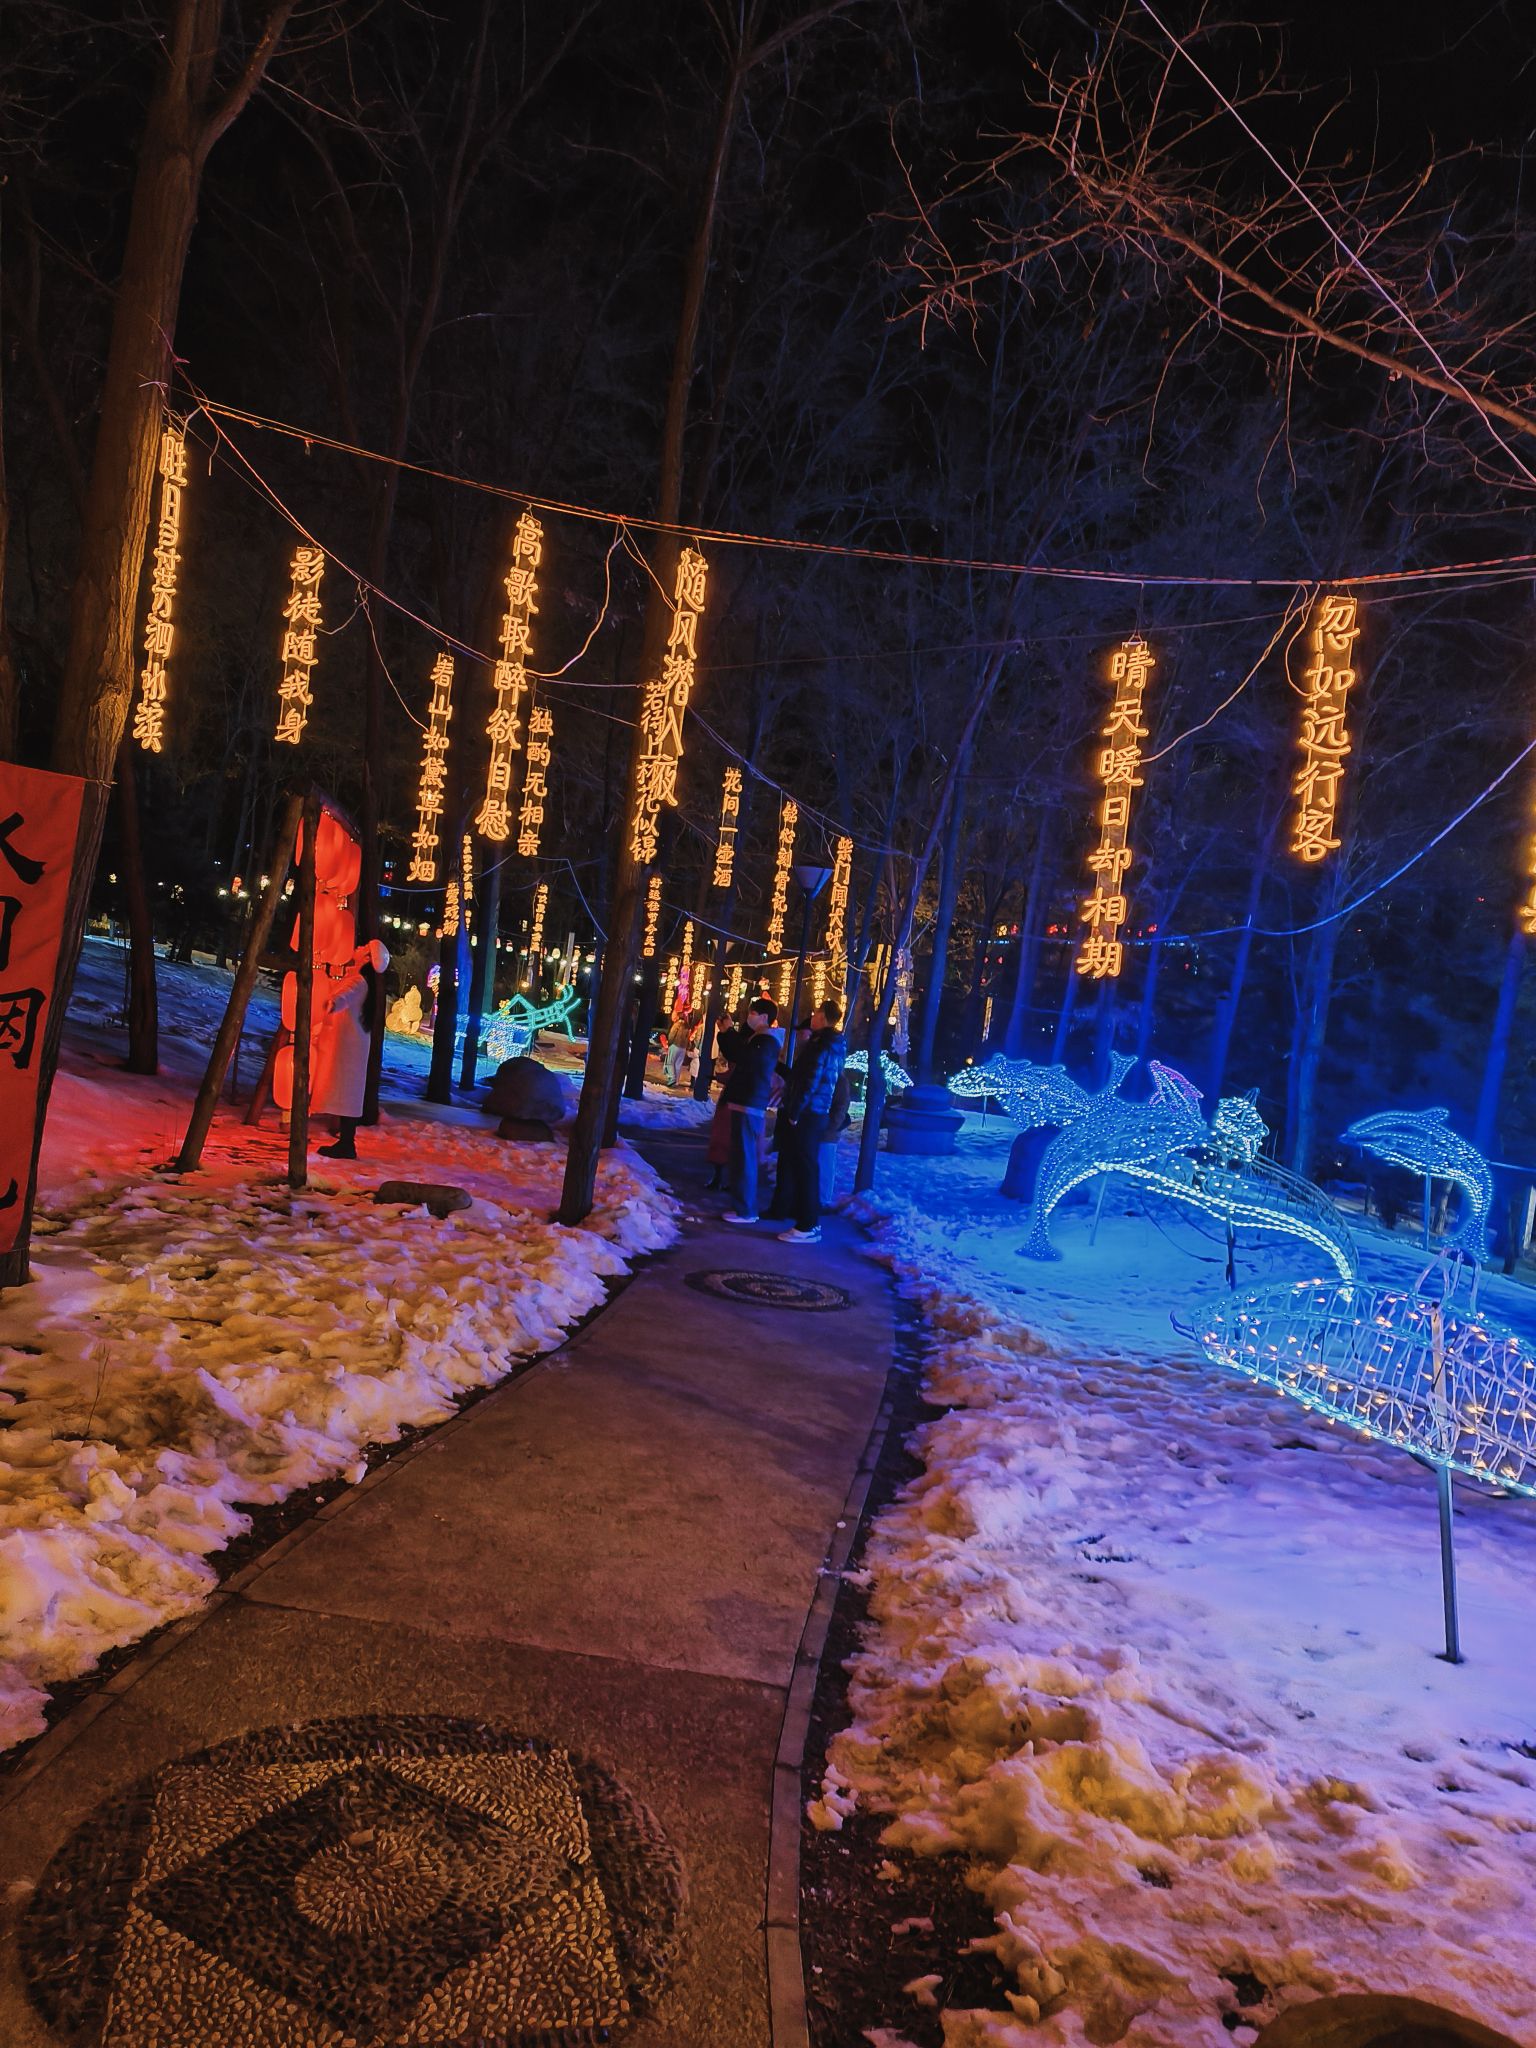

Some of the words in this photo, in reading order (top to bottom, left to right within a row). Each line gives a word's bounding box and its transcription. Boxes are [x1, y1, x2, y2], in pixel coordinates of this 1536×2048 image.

[274, 549, 325, 745] 影徒随我身
[475, 515, 544, 842] 高歌取醉欲自慰
[652, 550, 708, 807] 随风潜入夜
[1291, 597, 1361, 863] 忽如远行客
[517, 708, 555, 858] 独酌无相亲
[712, 769, 743, 888] 花间一壶酒
[766, 802, 799, 955] 铭心刻骨记在心
[1076, 646, 1156, 980] 晴天暖日却相期
[826, 837, 854, 953] 柴门闻犬吠
